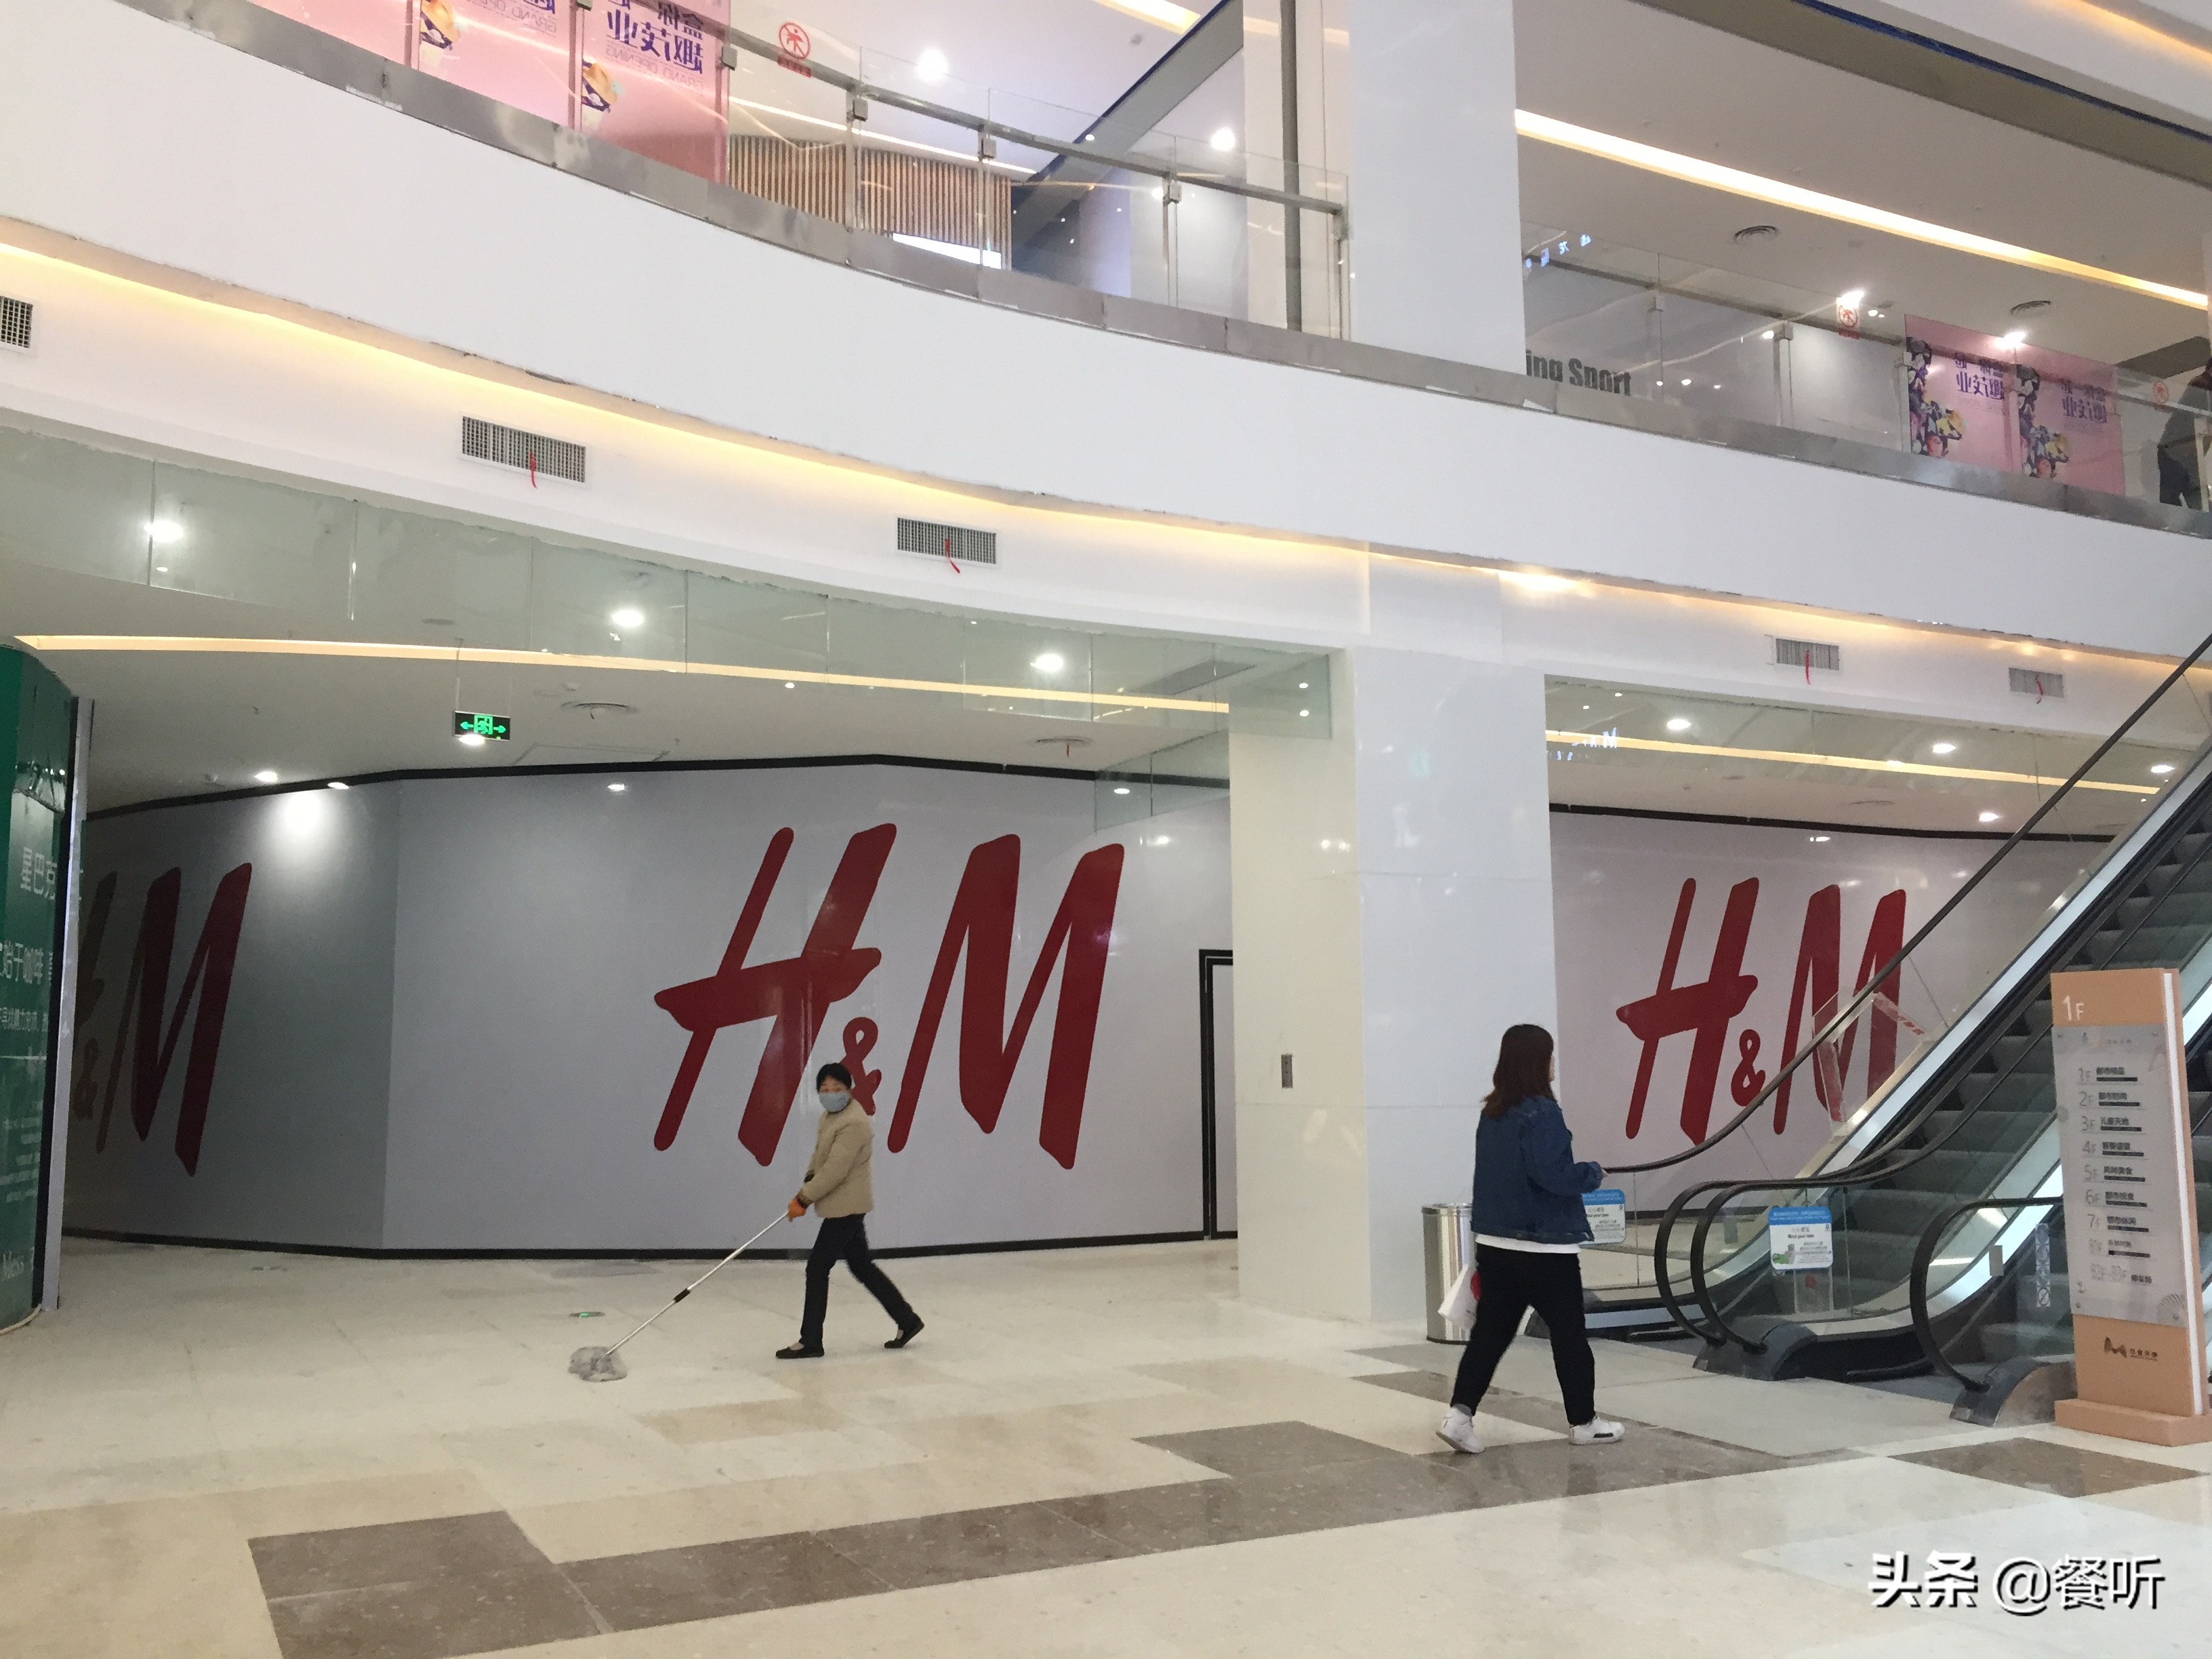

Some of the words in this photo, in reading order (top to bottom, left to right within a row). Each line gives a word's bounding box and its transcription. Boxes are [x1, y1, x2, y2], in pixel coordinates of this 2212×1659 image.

[654, 823, 1125, 1170] H&M
[1616, 877, 1906, 1147] H&M
[2062, 995, 2085, 1021] 1F
